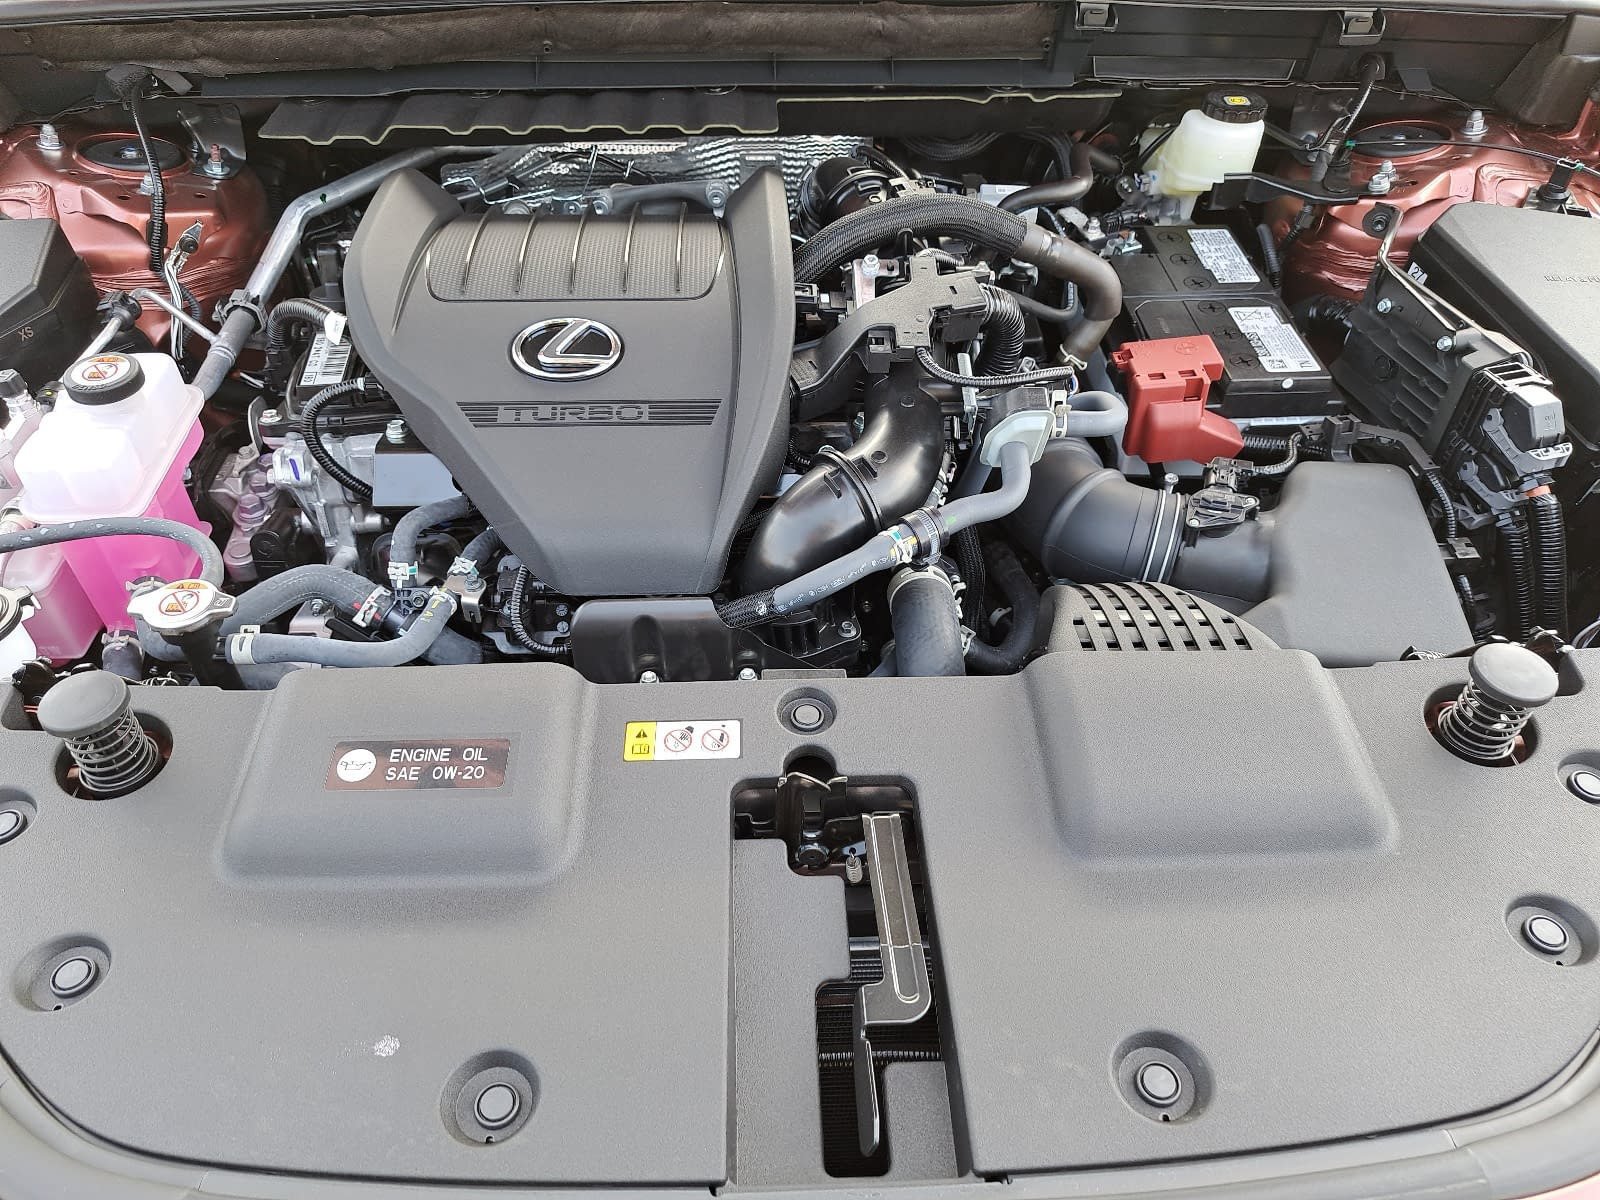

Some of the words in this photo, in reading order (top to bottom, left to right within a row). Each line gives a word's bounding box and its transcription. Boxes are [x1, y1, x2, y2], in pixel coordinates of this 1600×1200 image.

[1411, 266, 1425, 281] 27
[503, 404, 643, 422] TURBO
[389, 748, 451, 762] ENGINE
[462, 747, 488, 761] OIL
[385, 766, 420, 781] SAE
[432, 766, 485, 780] 0W-20
